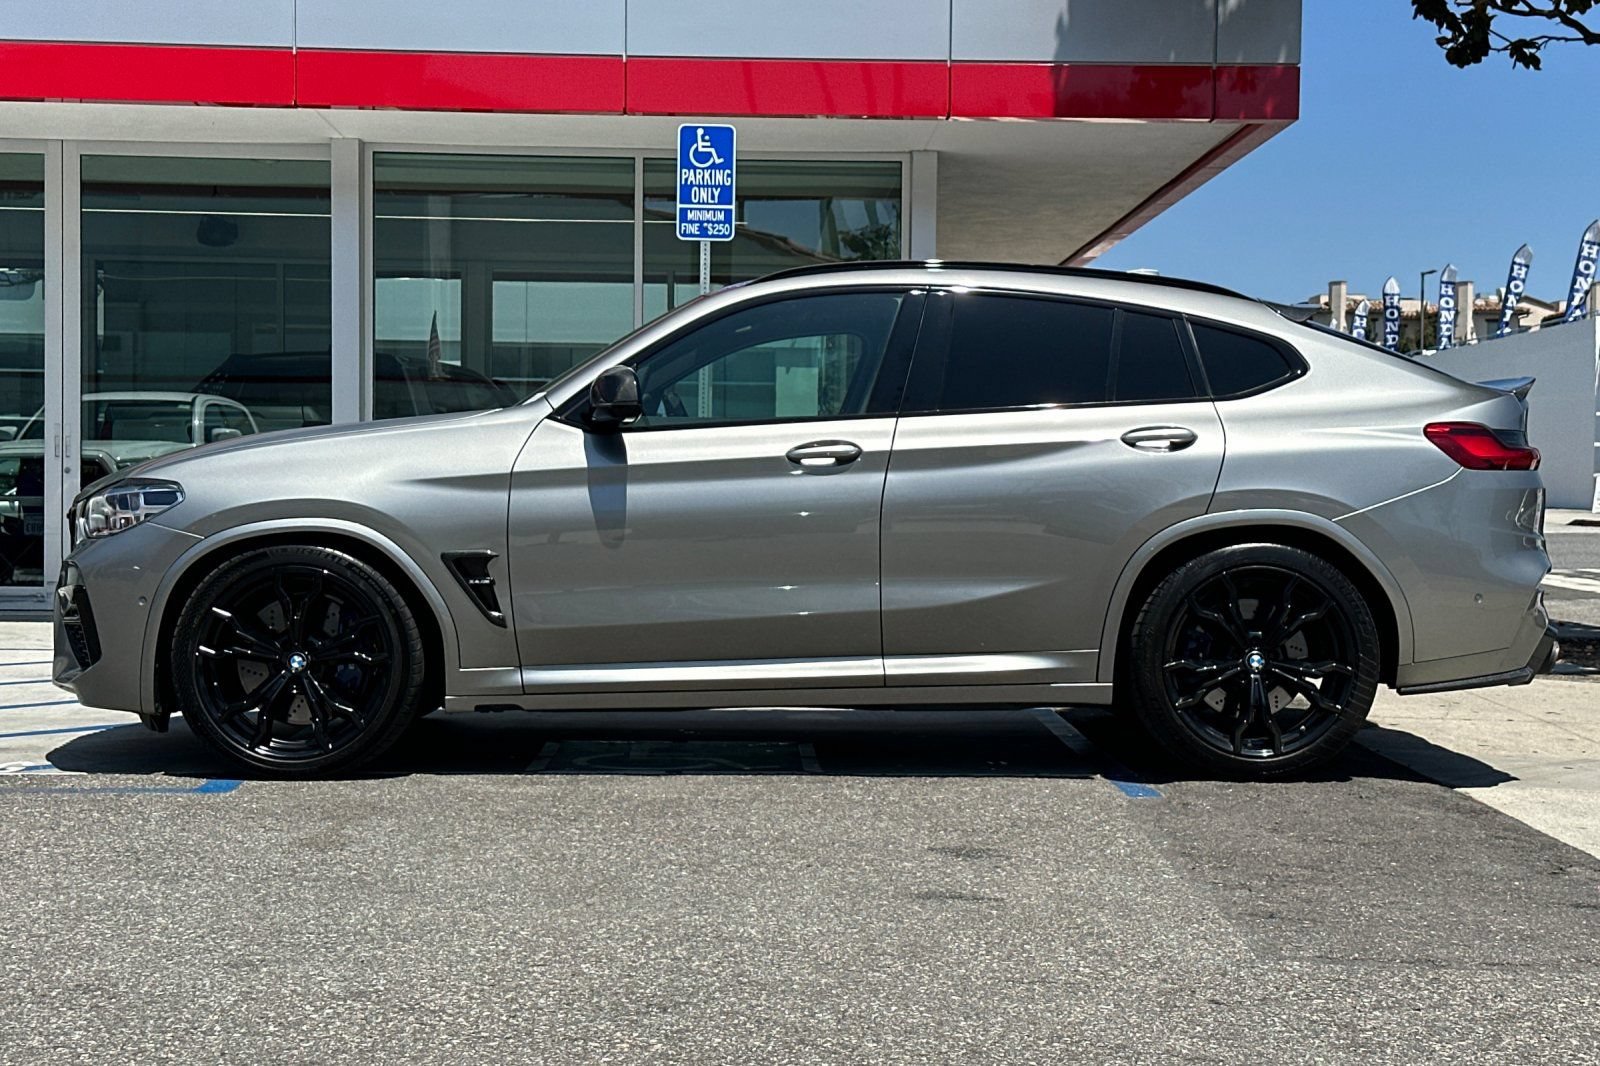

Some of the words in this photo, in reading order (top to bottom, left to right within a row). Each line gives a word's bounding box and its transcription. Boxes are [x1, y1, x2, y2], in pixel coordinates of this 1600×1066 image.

[681, 168, 732, 186] PARKING
[691, 186, 721, 204] ONLY
[687, 209, 725, 221] MINIMUM
[681, 222, 700, 235] FINE
[707, 223, 730, 236] $250
[1384, 295, 1400, 351] HOND
[1439, 283, 1456, 350] HONDA
